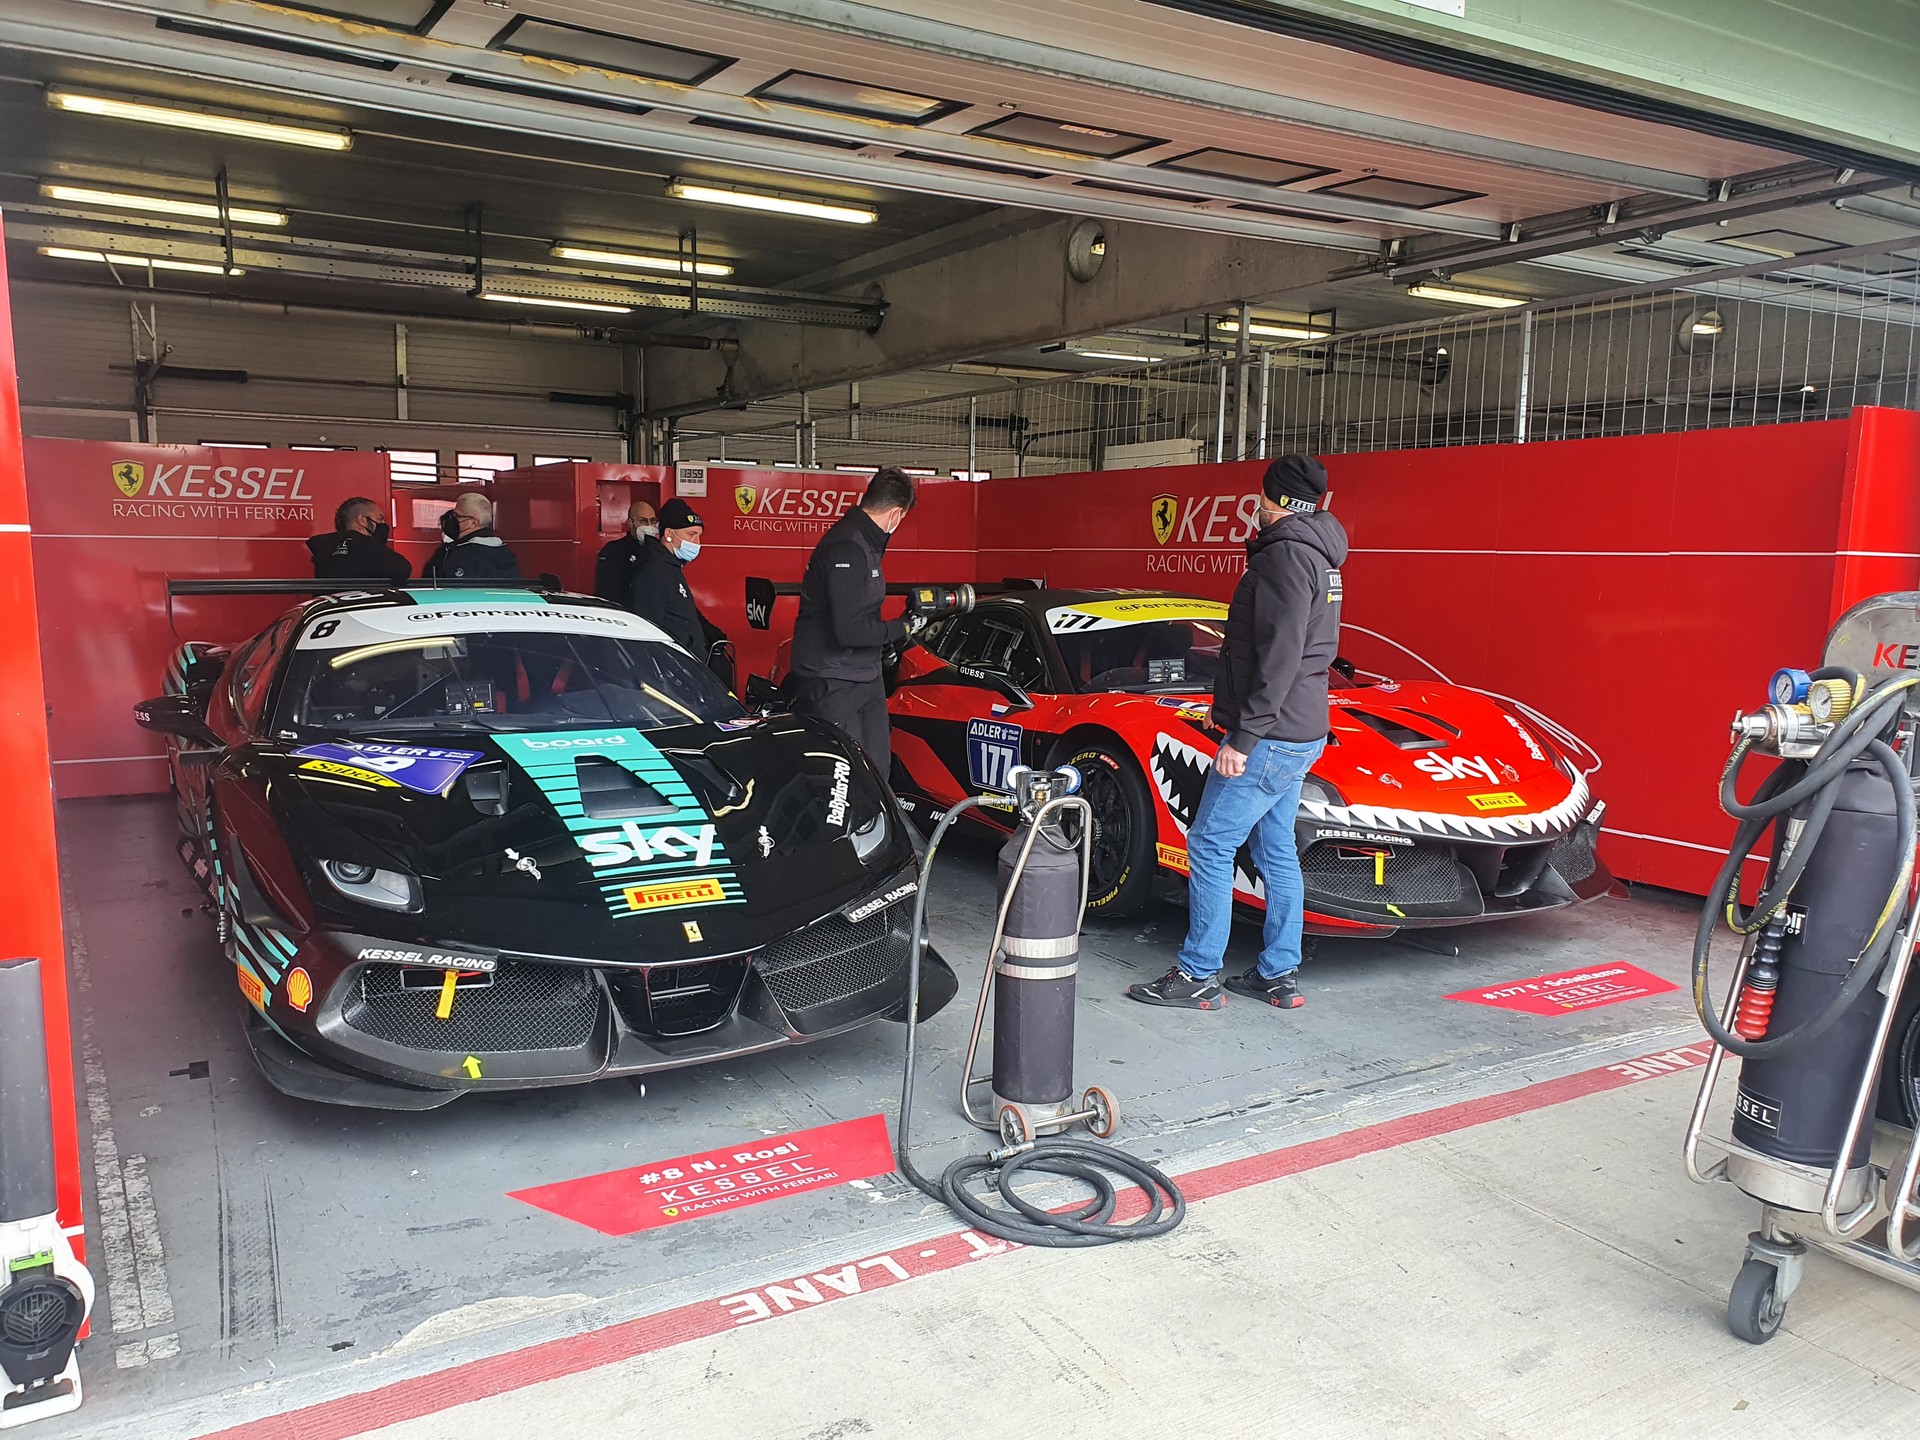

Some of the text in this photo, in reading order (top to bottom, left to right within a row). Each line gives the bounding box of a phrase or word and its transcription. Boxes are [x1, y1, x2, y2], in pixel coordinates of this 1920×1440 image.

[148, 464, 312, 499] KESSEL
[112, 503, 314, 521] RACING WITH FERRARI
[733, 518, 782, 532] RACING
[785, 521, 817, 532] WITH
[1146, 554, 1206, 573] RACING
[407, 609, 628, 627] @FerrariRaces
[747, 599, 766, 627] sky
[1053, 613, 1102, 630] 177
[309, 619, 342, 640] 8
[1872, 641, 1920, 669] KE
[960, 666, 985, 680] GUESS
[970, 721, 1001, 740] ADLER
[348, 744, 428, 757] ADLER
[521, 735, 627, 749] board
[312, 761, 390, 784] Sabelt
[980, 742, 1013, 789] 177
[1413, 751, 1500, 785] sky
[1475, 795, 1520, 807] PIRELLI
[581, 821, 716, 866] sky
[1316, 829, 1412, 844] KESSEL RACING
[1159, 846, 1190, 867] PIREL
[634, 883, 715, 904] PIRELLI
[849, 882, 918, 921] KESSEL RACING
[1087, 885, 1119, 908] PIRELLI
[358, 948, 495, 970] KESSEL RACING
[1543, 982, 1626, 1002] KESSEL
[1606, 1047, 1710, 1080] LANE
[1736, 1095, 1771, 1123] SSEL
[639, 1167, 684, 1185] #8
[690, 1160, 727, 1173] N.
[661, 1162, 814, 1203] KESSEL
[681, 1172, 839, 1213] RACING WITH FERRARI
[720, 1255, 910, 1324] LANE
